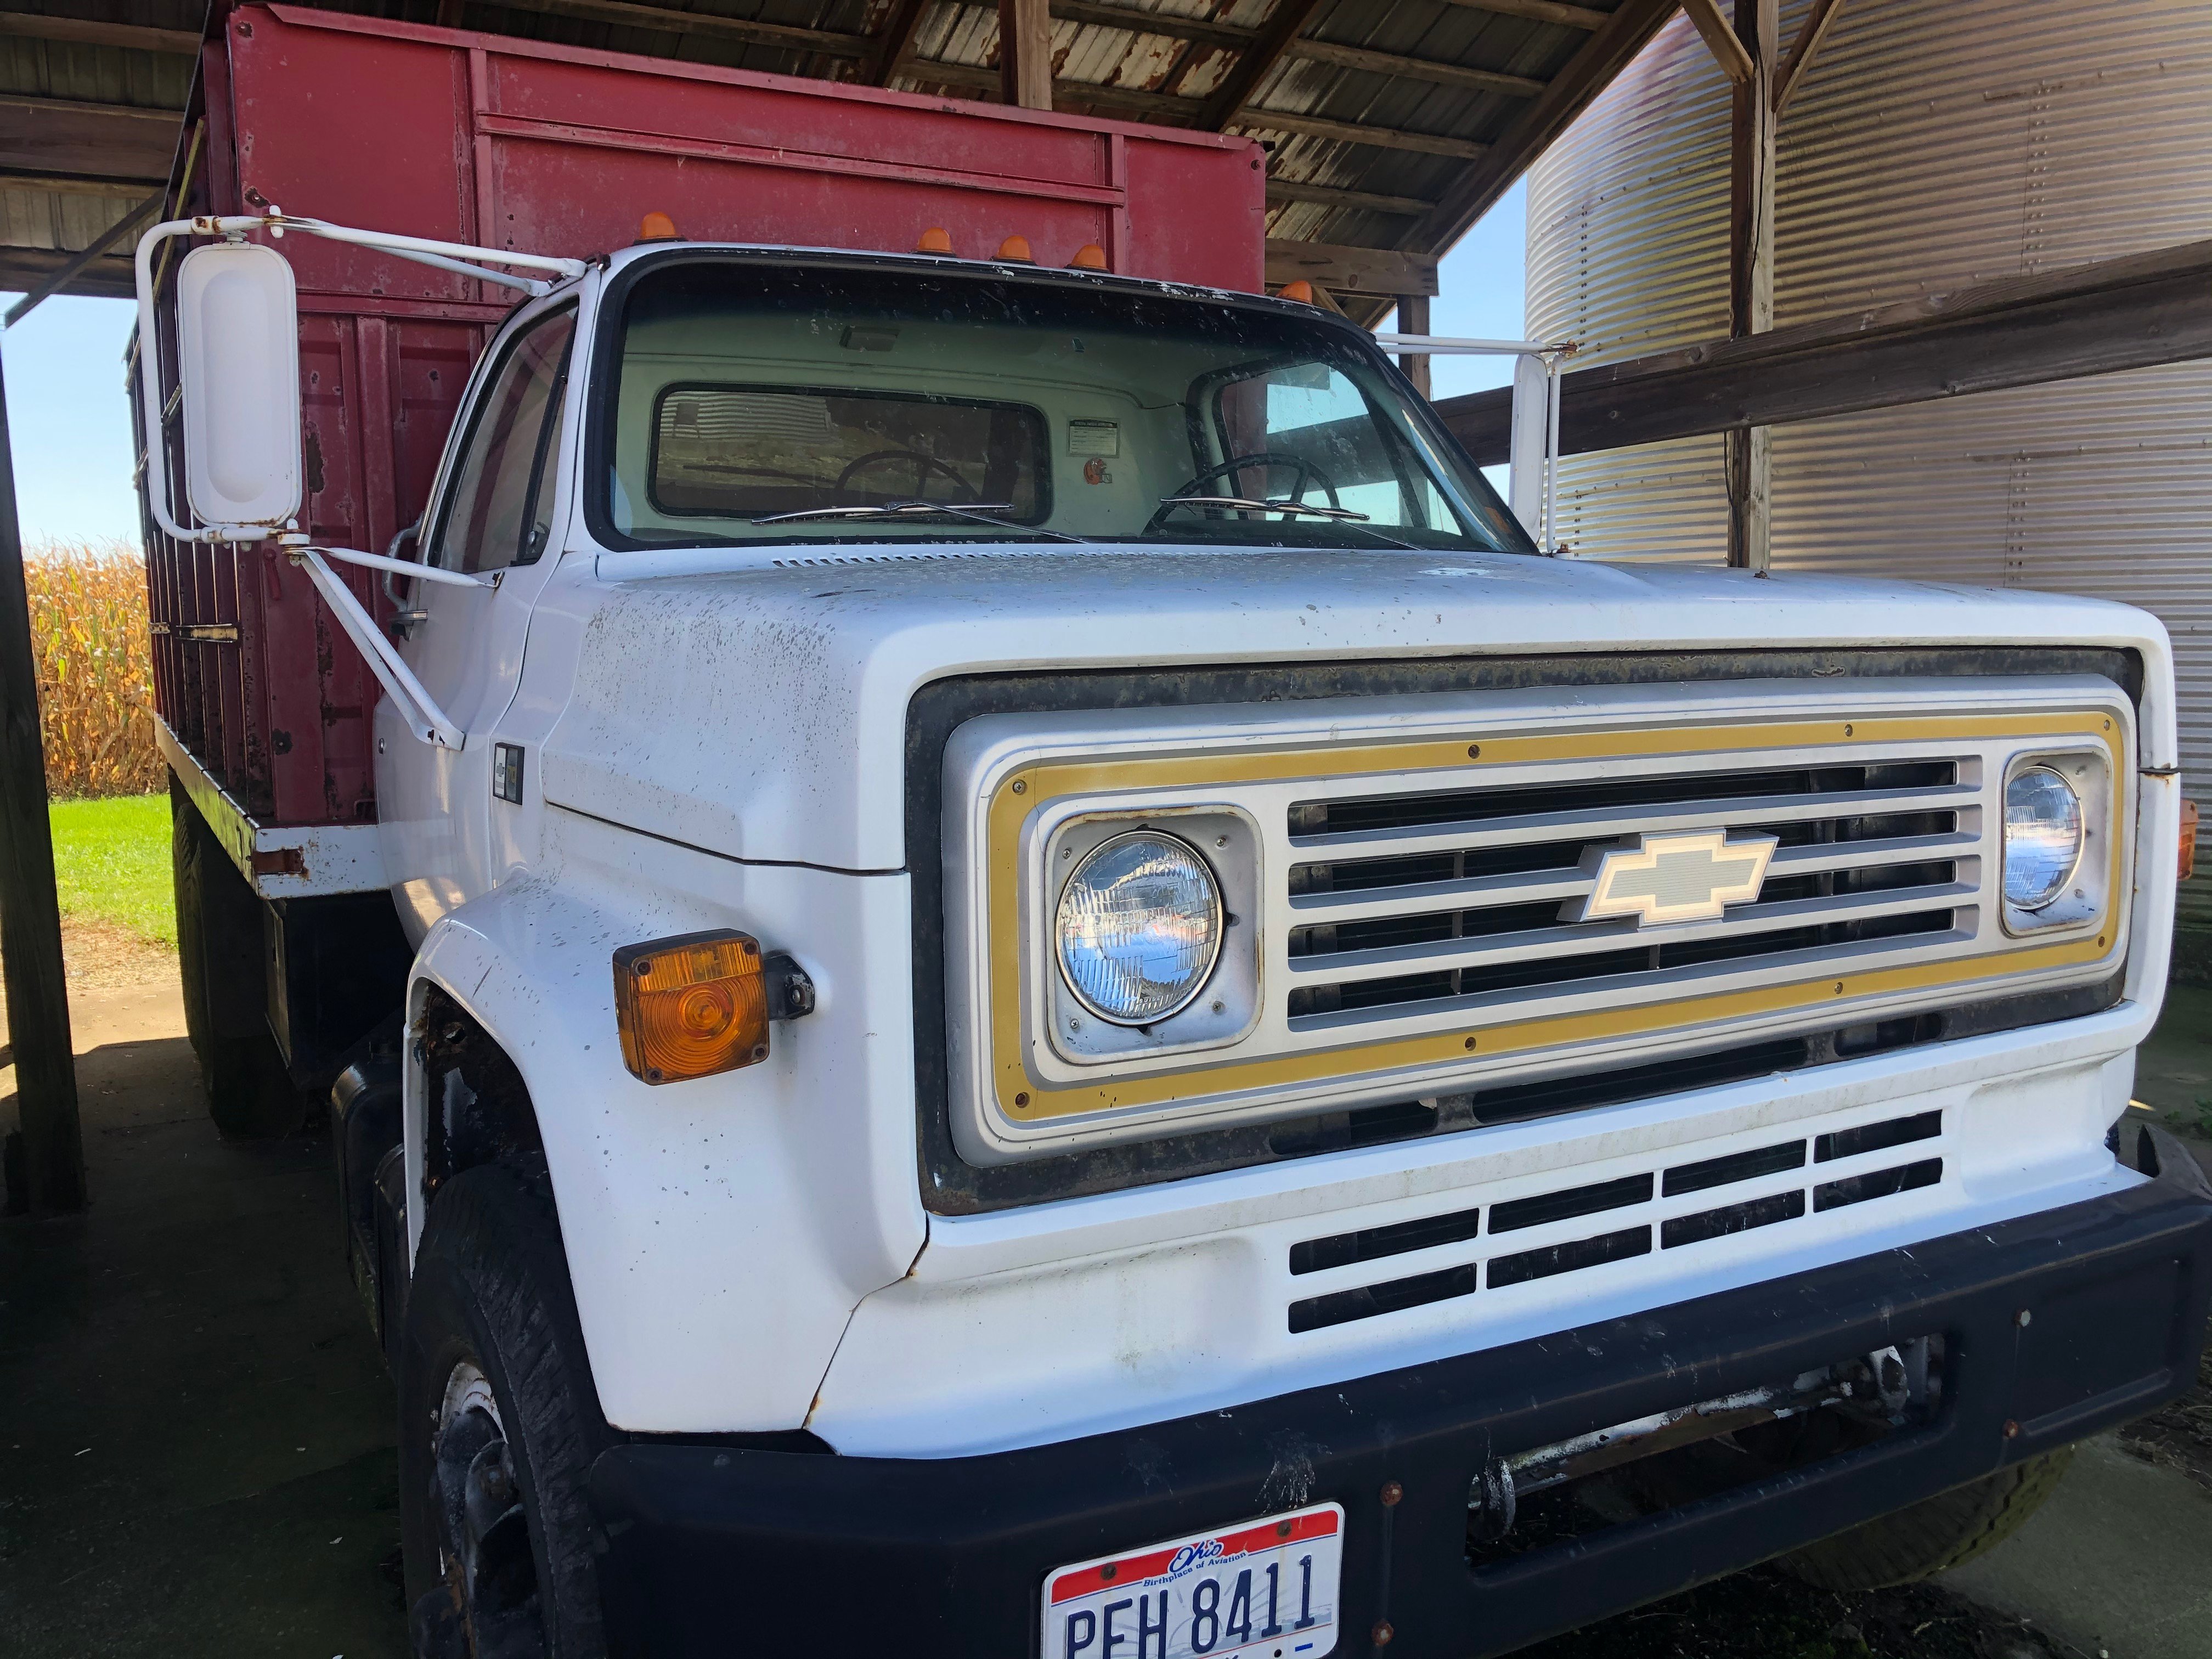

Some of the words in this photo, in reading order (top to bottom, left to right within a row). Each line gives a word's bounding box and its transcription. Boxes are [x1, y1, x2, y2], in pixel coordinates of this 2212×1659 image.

[1143, 1567, 1193, 1587] Birthplace
[1196, 1561, 1205, 1570] of
[1207, 1553, 1246, 1566] Aviation
[1169, 1541, 1222, 1573] Ohio
[1190, 1554, 1315, 1654] 8411
